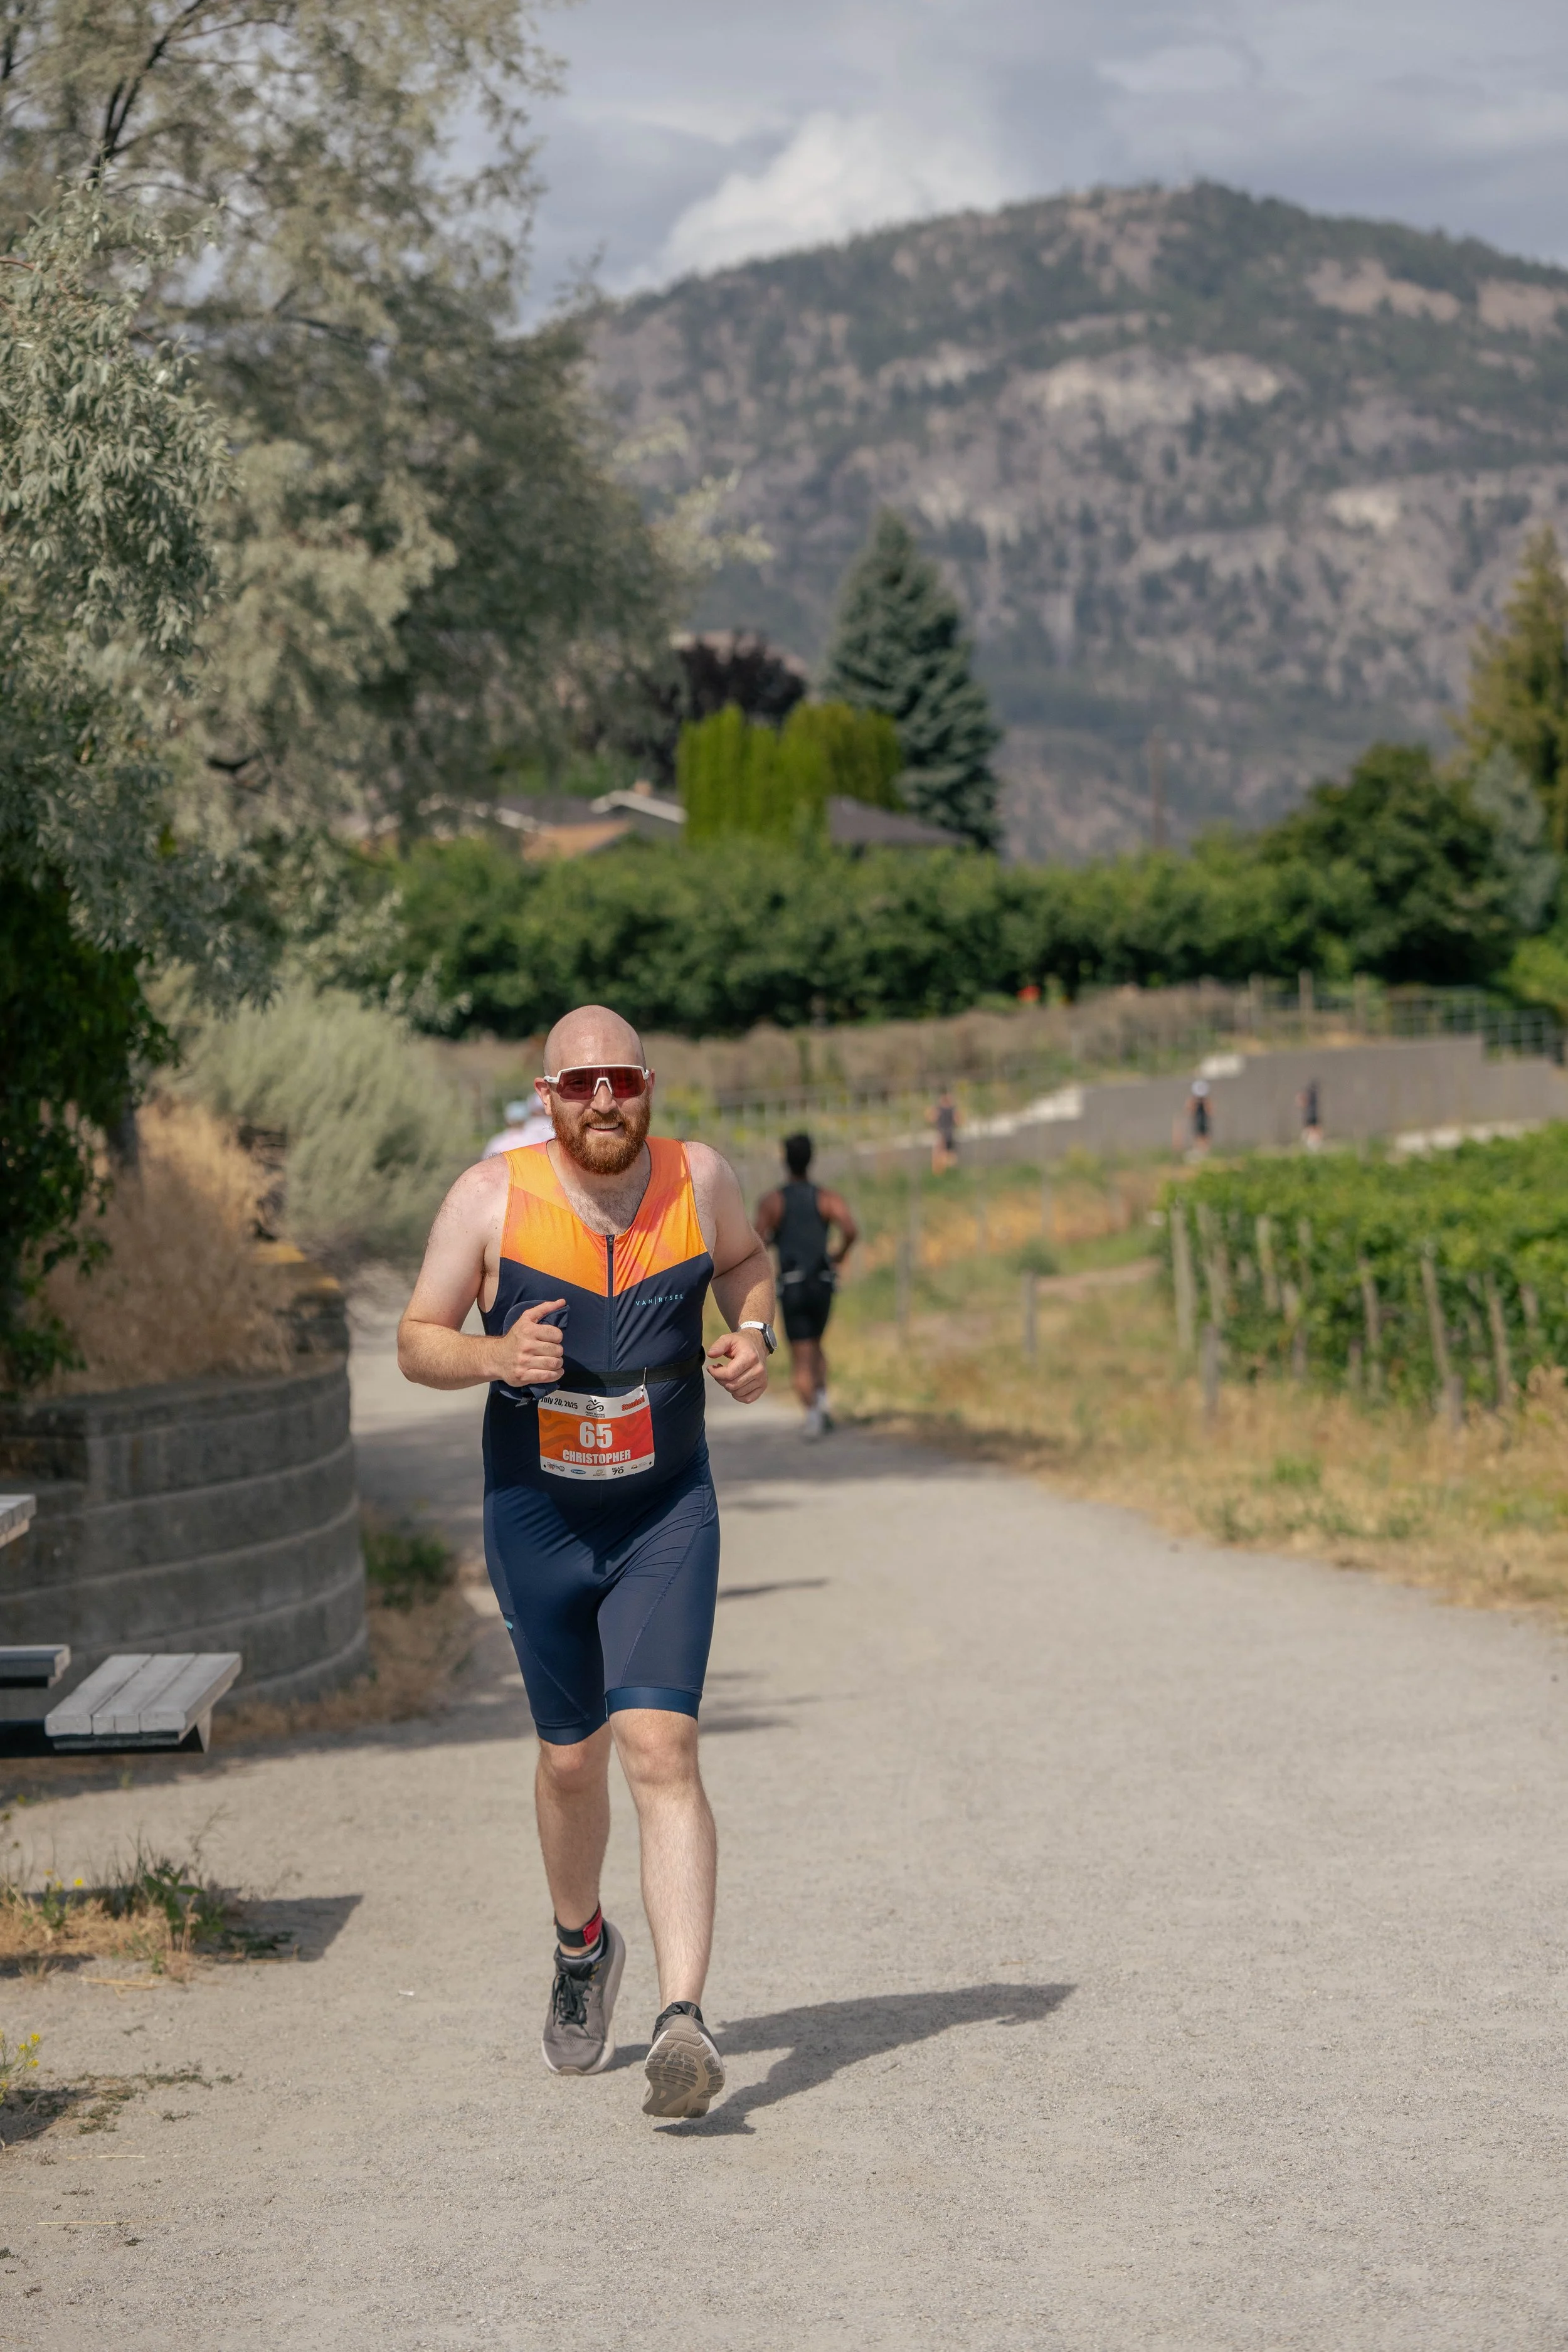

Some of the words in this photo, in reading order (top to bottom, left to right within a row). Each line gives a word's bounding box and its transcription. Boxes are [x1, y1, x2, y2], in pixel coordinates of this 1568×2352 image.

[659, 1294, 684, 1303] RYSEL
[541, 1396, 553, 1404] July
[554, 1398, 563, 1407] 20,
[564, 1400, 578, 1409] 2025
[622, 1395, 645, 1411] Standard
[580, 1421, 613, 1448] 65
[563, 1449, 631, 1464] CHRISTOPHER
